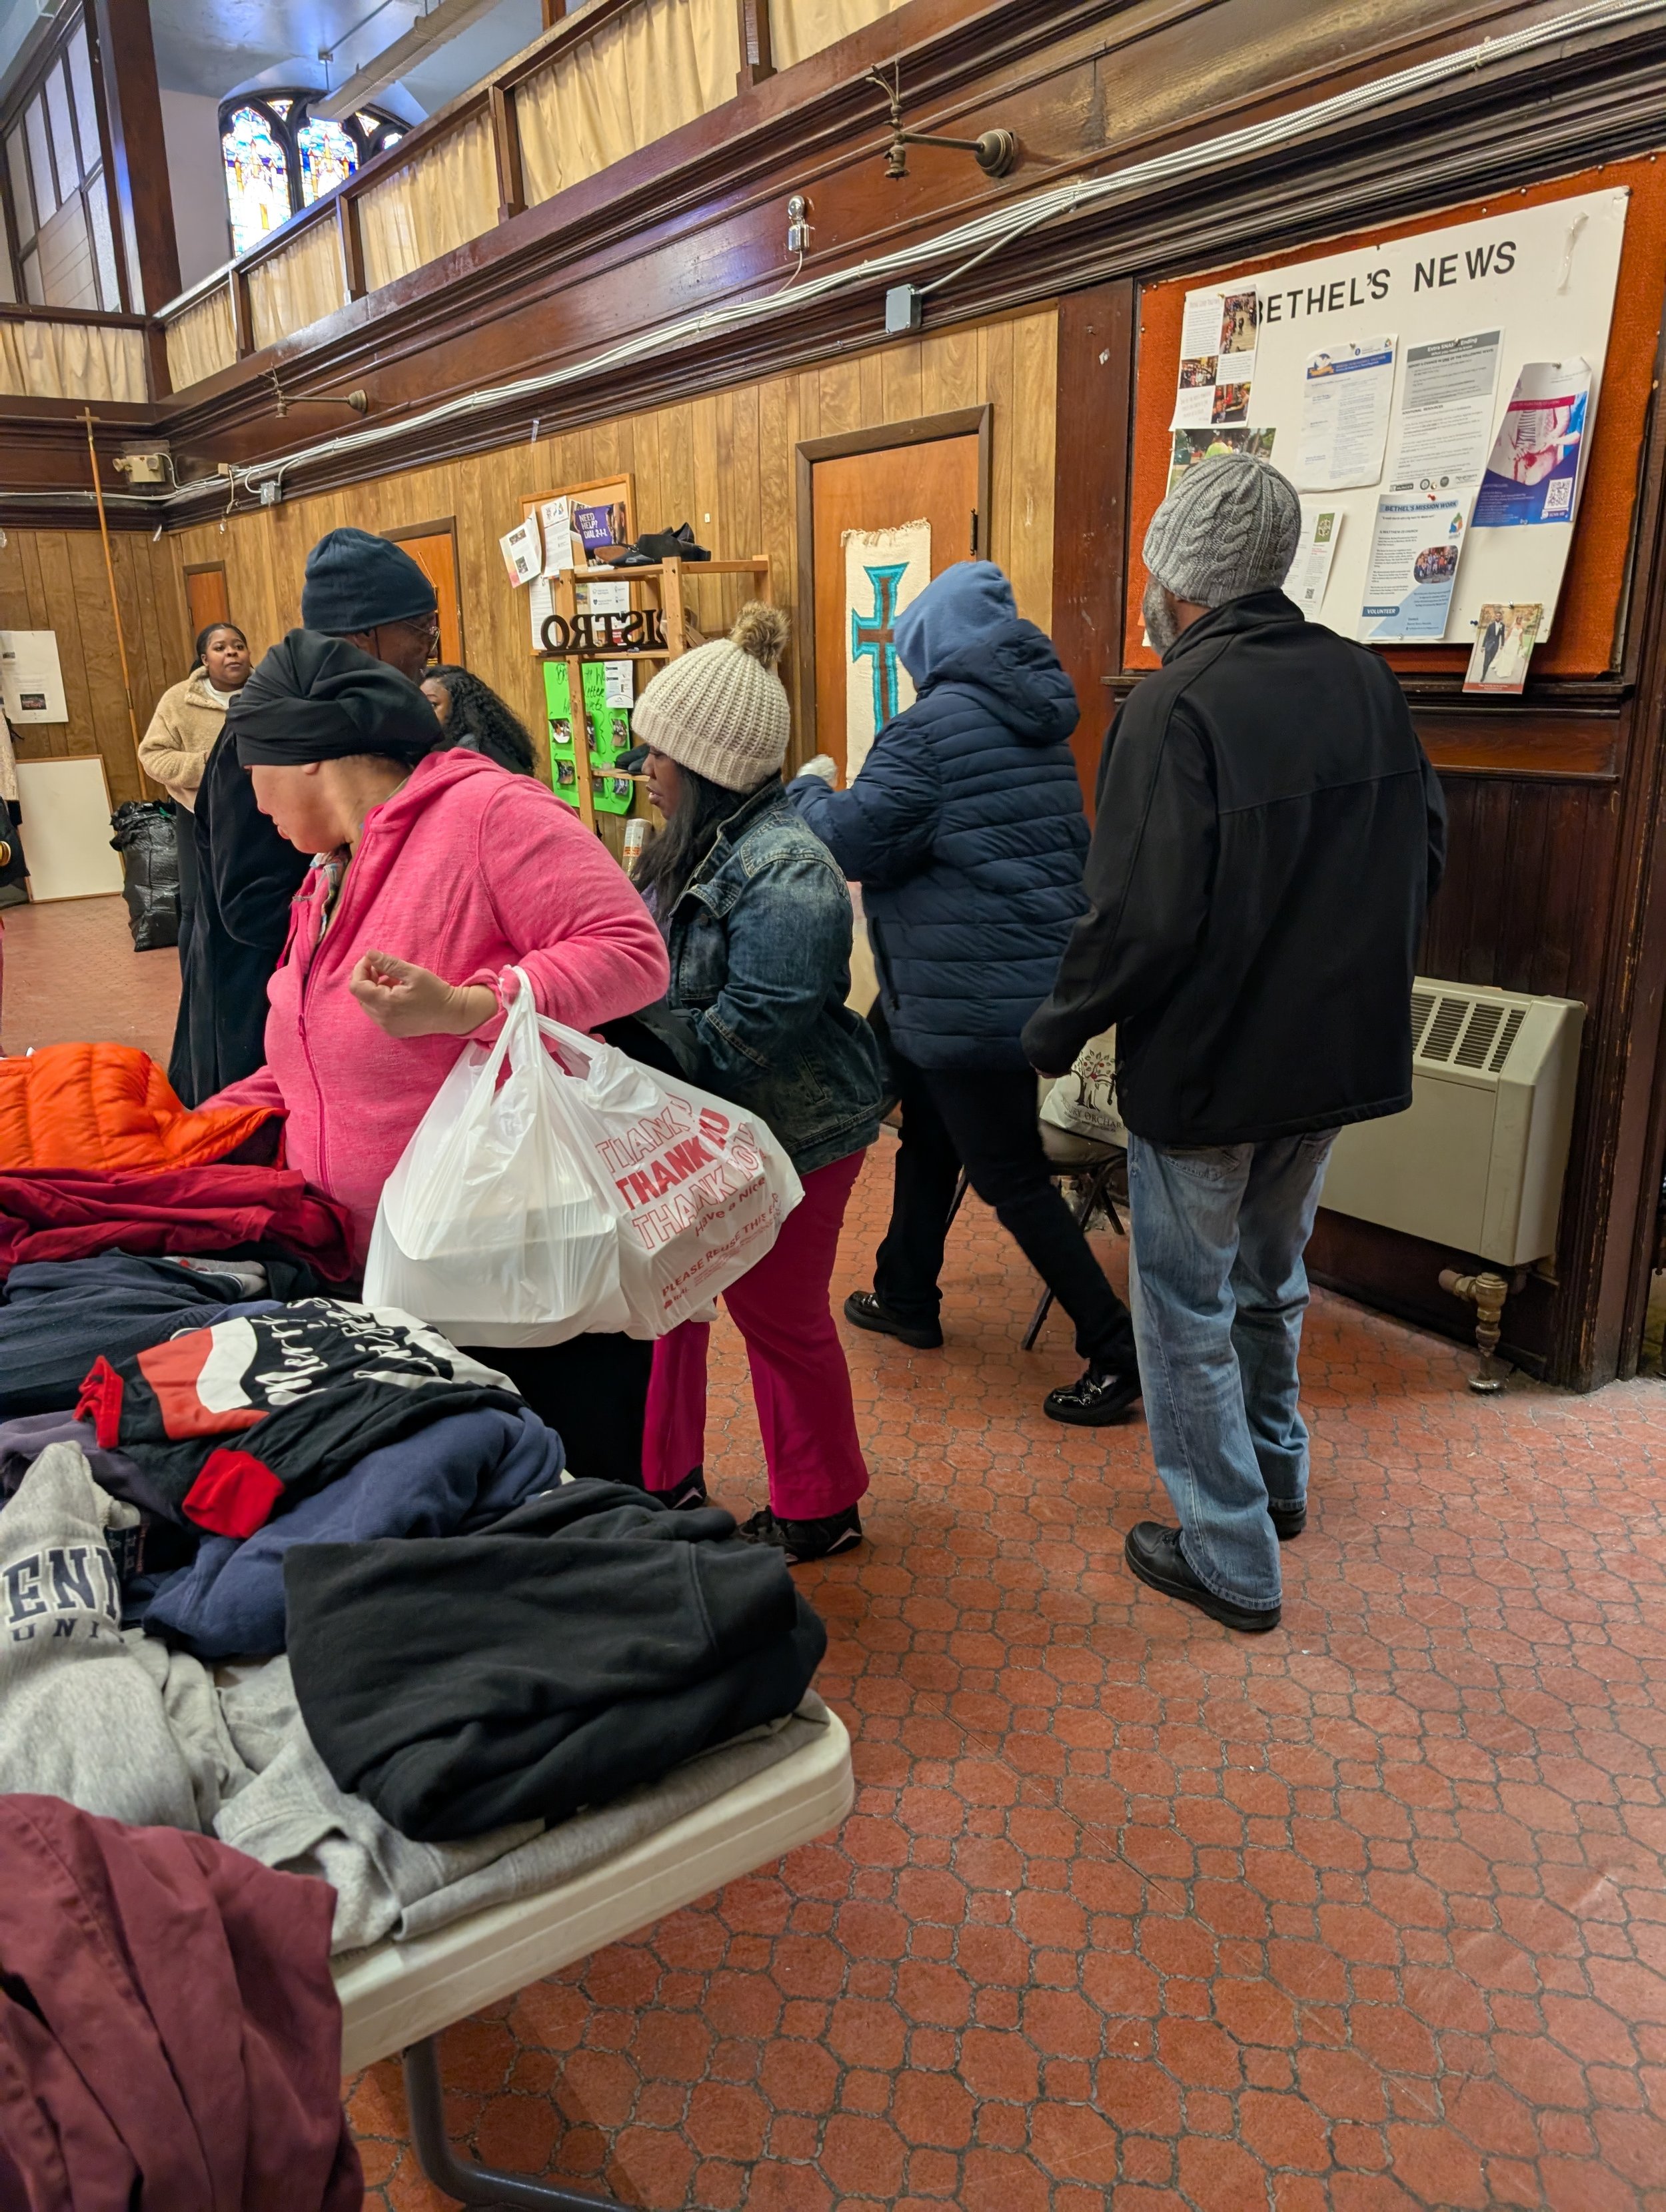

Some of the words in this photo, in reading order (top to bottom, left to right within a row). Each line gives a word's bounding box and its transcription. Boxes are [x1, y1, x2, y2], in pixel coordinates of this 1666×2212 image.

[1413, 241, 1517, 292] NEWS
[578, 512, 595, 523] NEED
[580, 520, 598, 530] HELP?
[583, 530, 596, 539] DIAL
[615, 1135, 717, 1211] THANK
[632, 1166, 738, 1250] THANK
[695, 1210, 726, 1237] Have
[728, 1203, 736, 1211] a
[739, 1177, 765, 1202] Nice
[662, 1259, 704, 1297] PLEASE
[706, 1231, 740, 1263] REUSE
[742, 1213, 766, 1234] THIS
